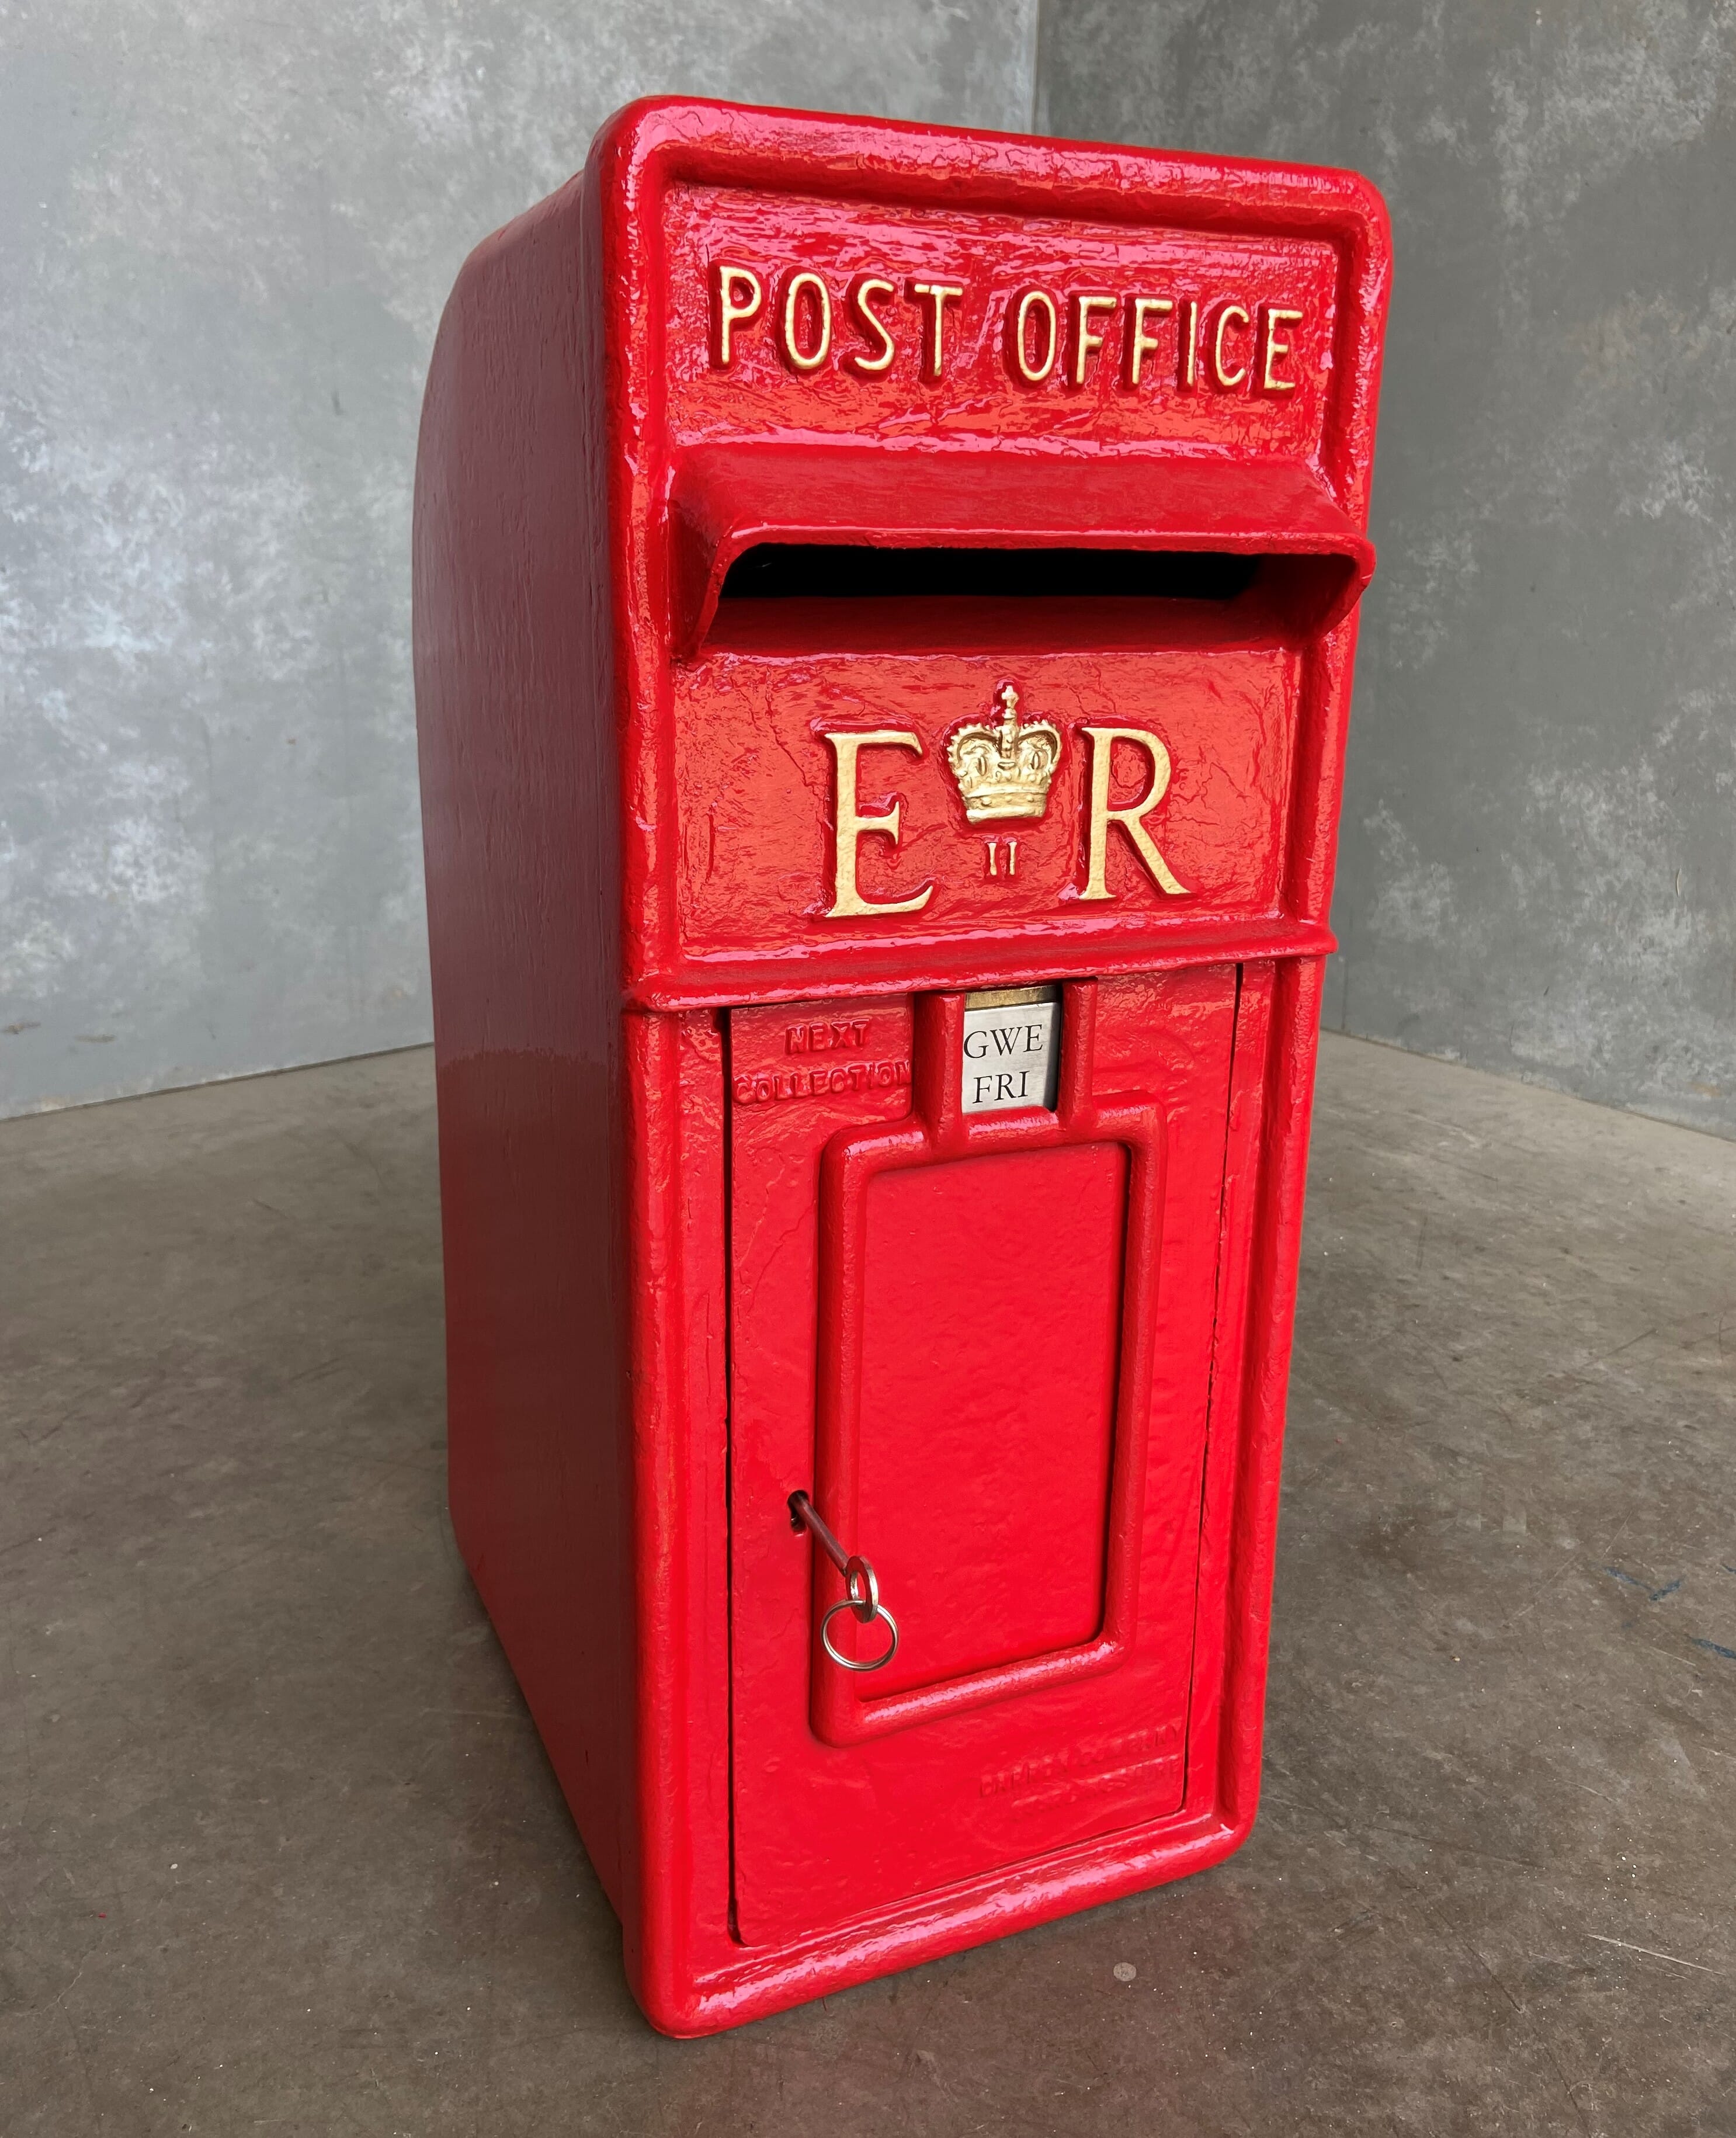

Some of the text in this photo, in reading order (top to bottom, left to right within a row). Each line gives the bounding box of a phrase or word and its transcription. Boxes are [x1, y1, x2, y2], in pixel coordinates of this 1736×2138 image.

[719, 265, 1304, 390] POST OFFICE
[825, 726, 1195, 918] E R
[784, 1019, 870, 1054] NEXT
[963, 1023, 1044, 1059] GWE
[732, 1058, 912, 1104] COLLECTION
[971, 1070, 1030, 1105] FRI
